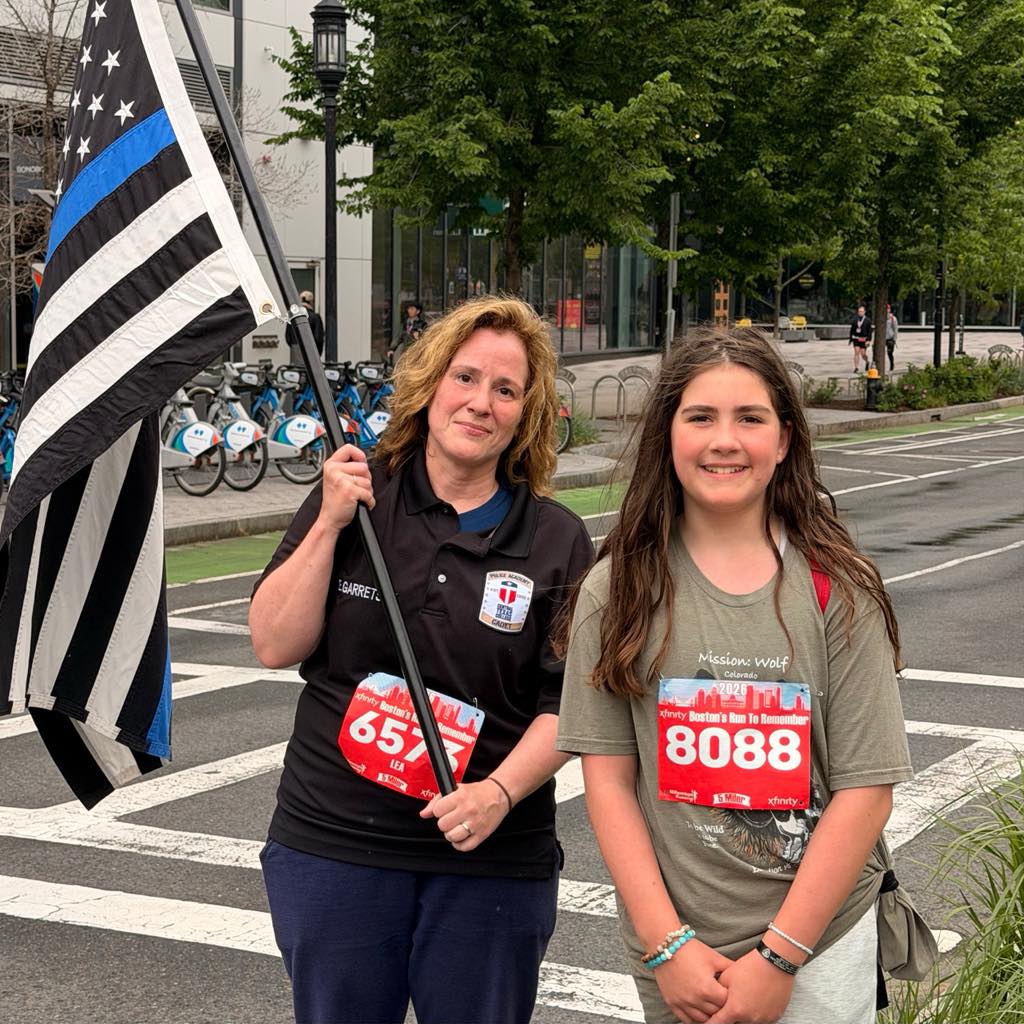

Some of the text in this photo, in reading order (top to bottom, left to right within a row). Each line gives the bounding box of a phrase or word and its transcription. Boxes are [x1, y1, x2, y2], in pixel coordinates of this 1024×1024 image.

[491, 618, 513, 630] CADET
[698, 650, 790, 673] Mission: Wolf
[724, 671, 758, 680] Colorado
[719, 683, 748, 696] 2026
[379, 700, 411, 721] Boston's
[660, 709, 687, 720] xfinity
[689, 710, 809, 726] Boston's Run To Remember
[666, 725, 802, 772] 8088
[390, 758, 405, 773] LEA
[768, 795, 798, 807] xfinity
